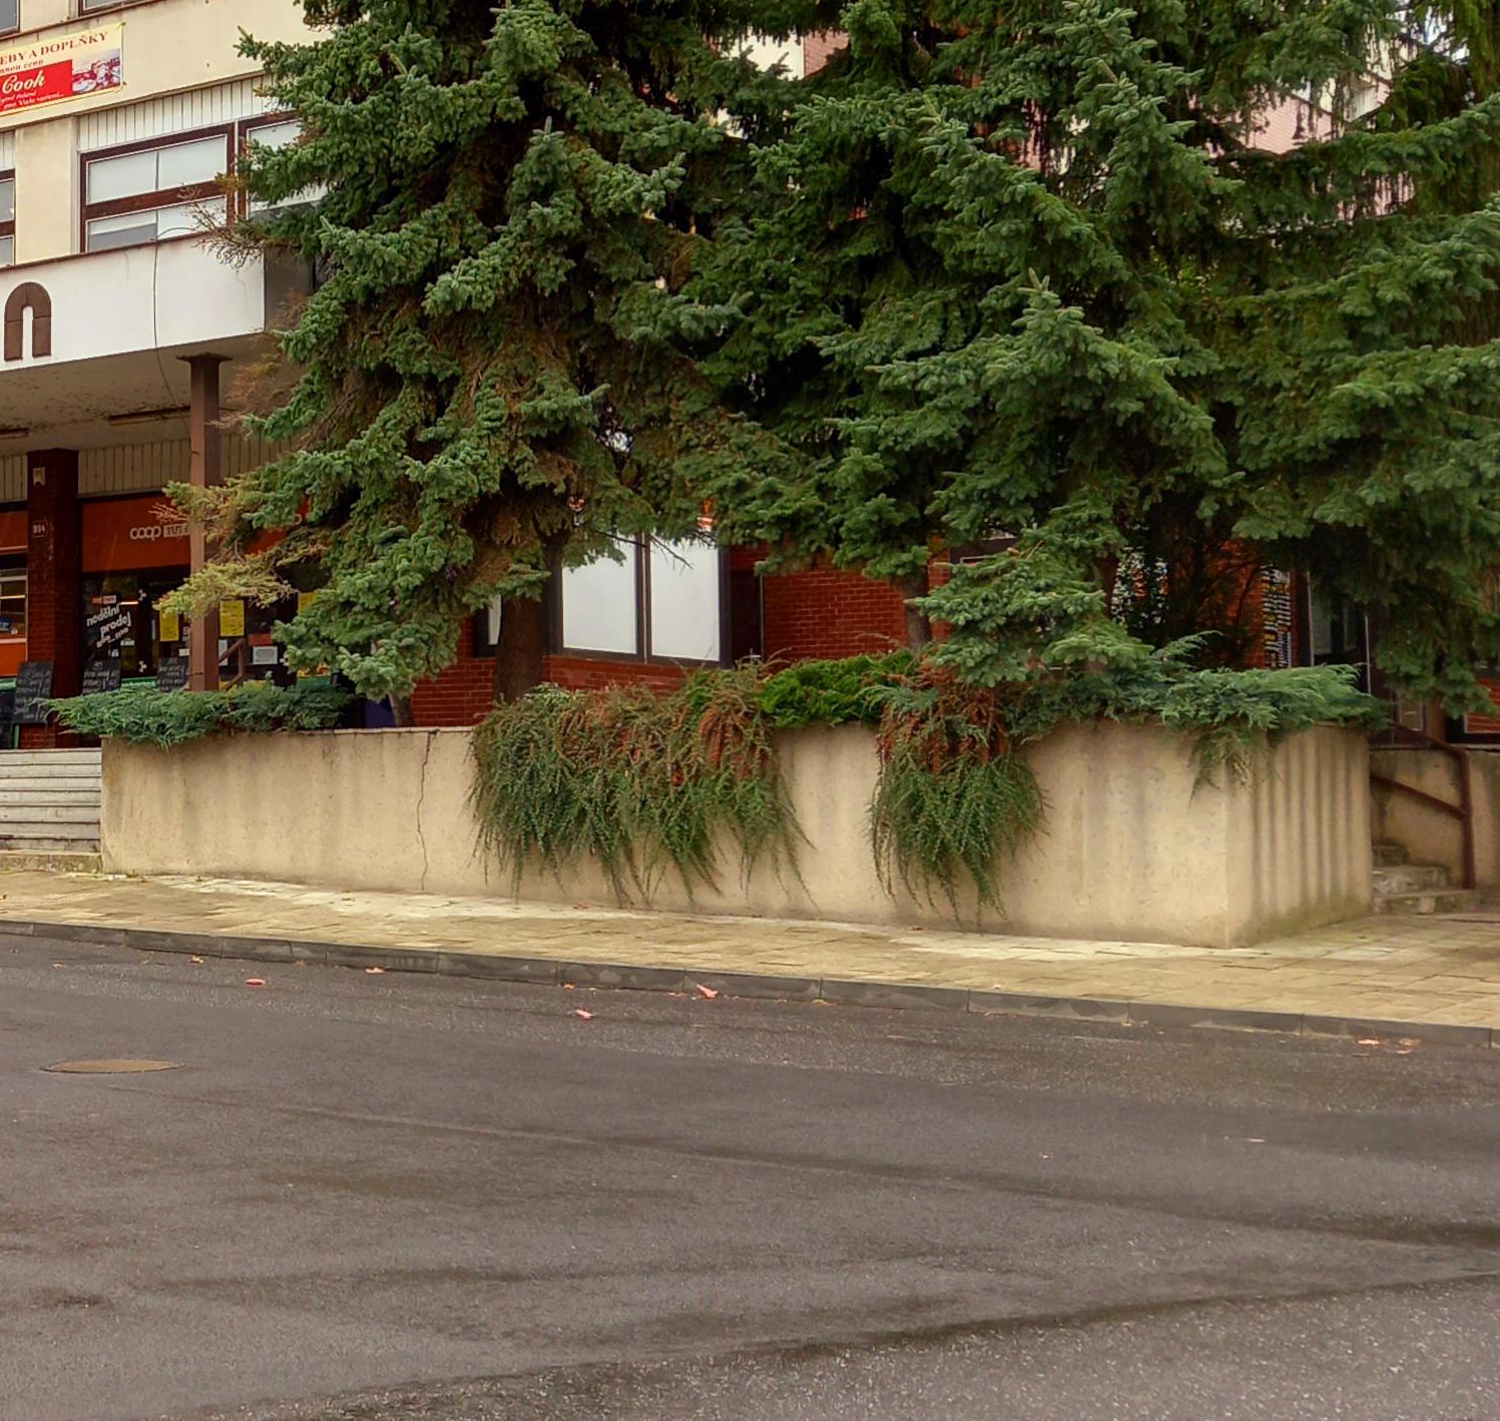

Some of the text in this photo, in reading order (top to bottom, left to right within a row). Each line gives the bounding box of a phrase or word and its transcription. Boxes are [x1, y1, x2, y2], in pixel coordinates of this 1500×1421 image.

[29, 49, 38, 59] A
[40, 31, 109, 57] DOPLŇKY
[1, 69, 46, 95] Cook
[130, 525, 162, 541] coop
[100, 611, 132, 639] prodej
